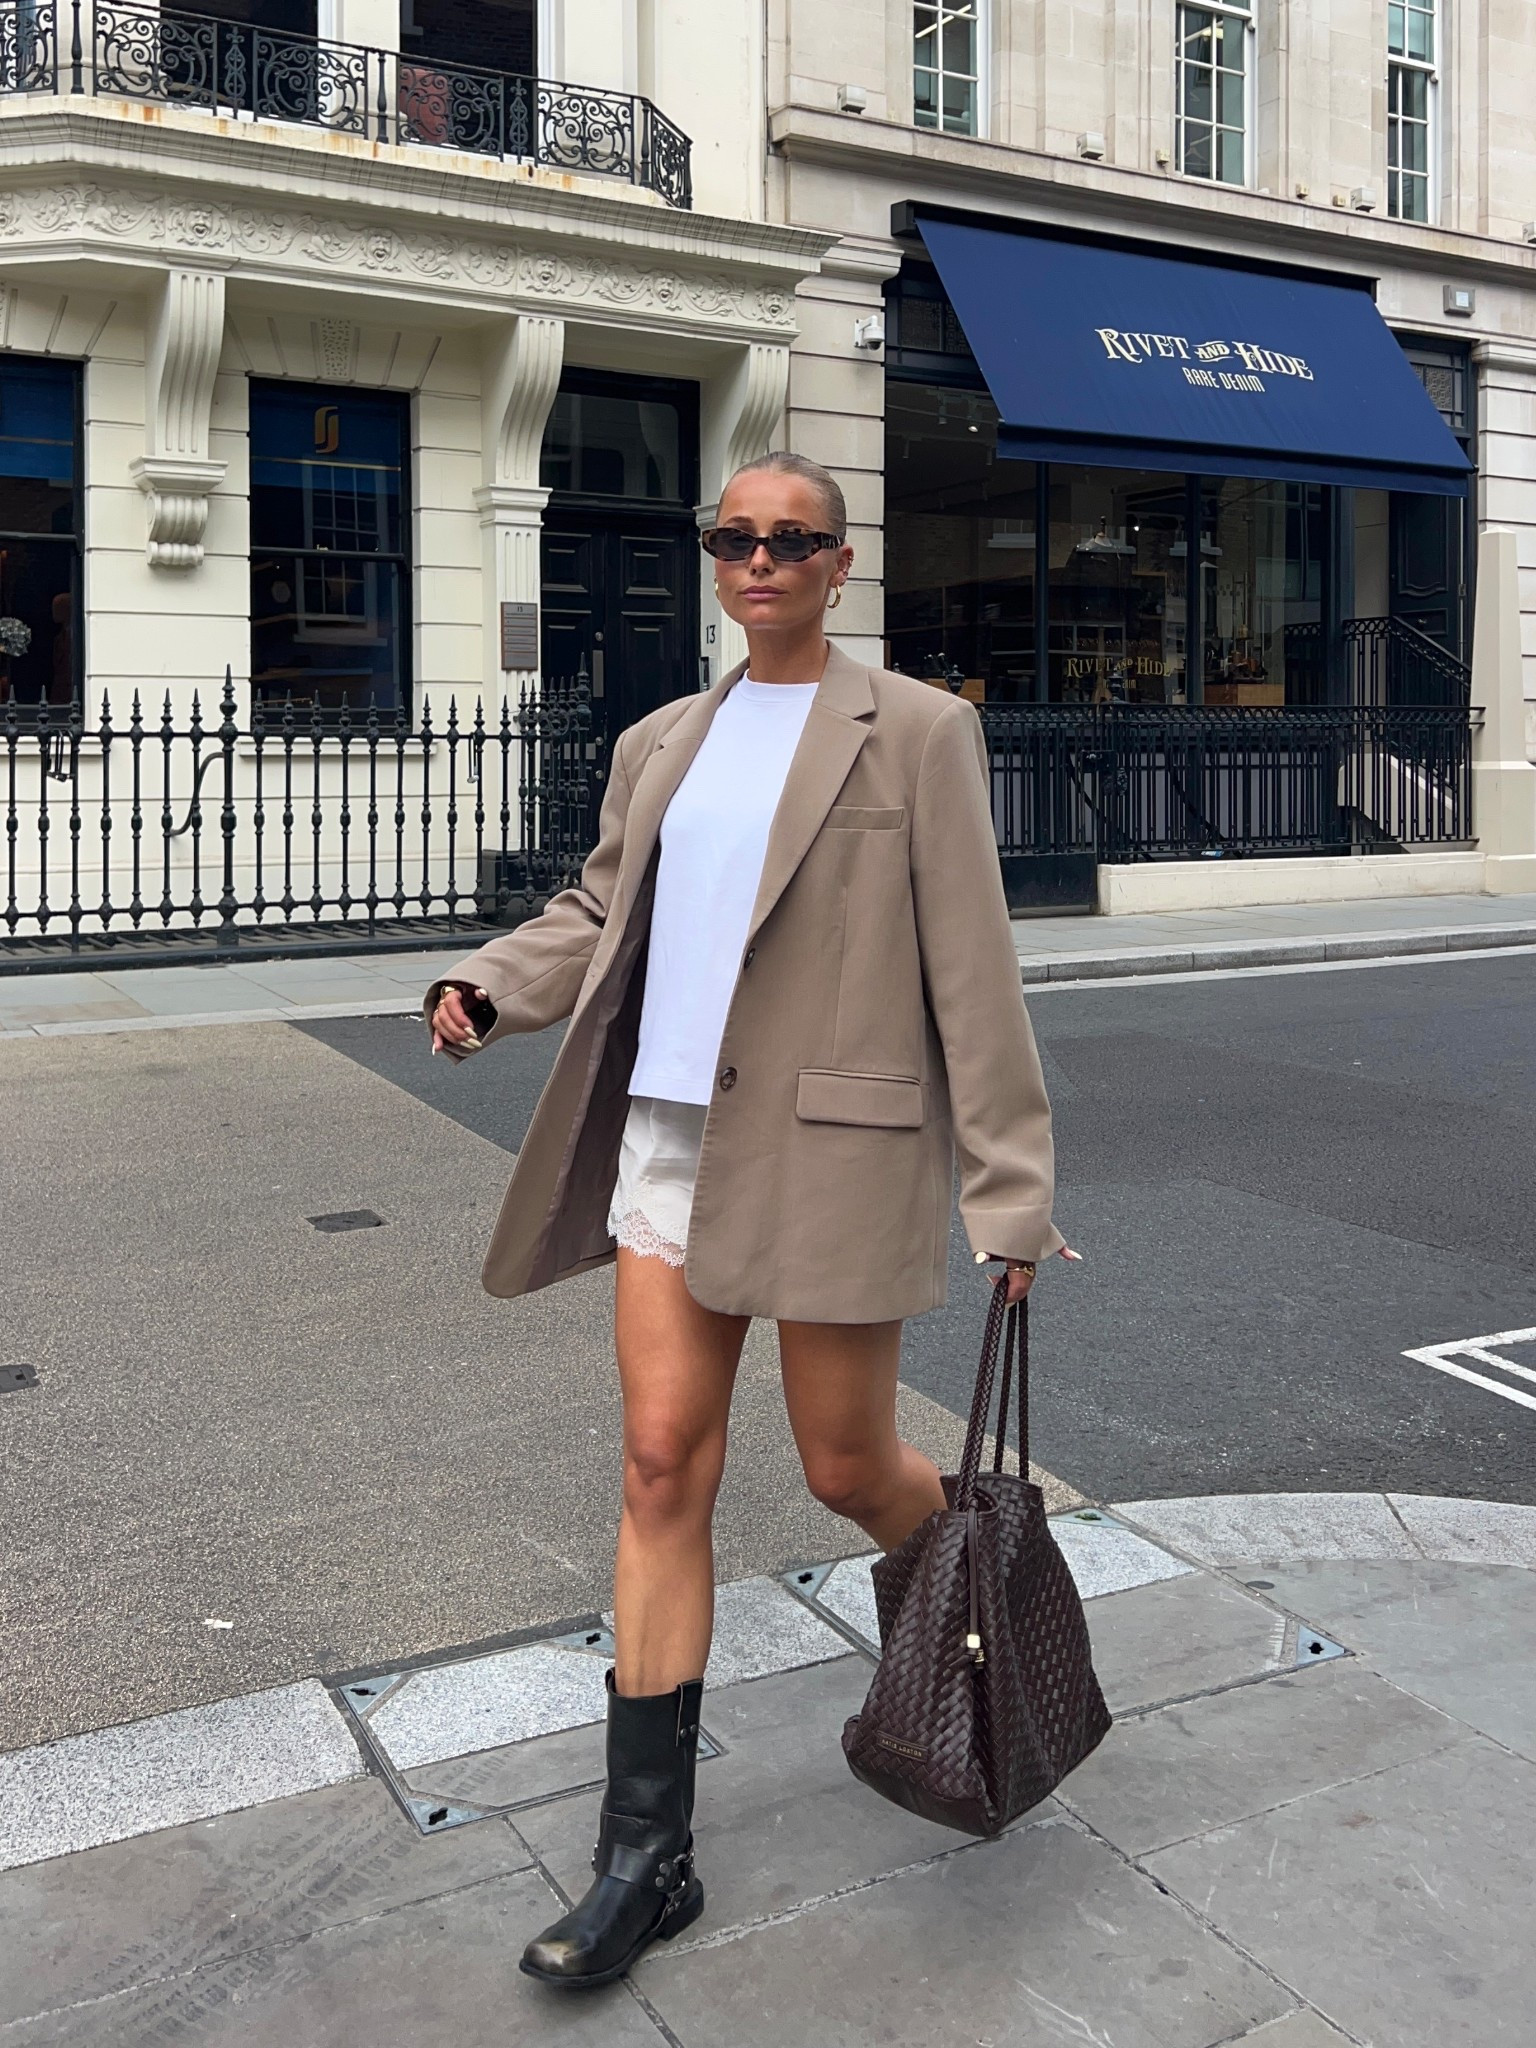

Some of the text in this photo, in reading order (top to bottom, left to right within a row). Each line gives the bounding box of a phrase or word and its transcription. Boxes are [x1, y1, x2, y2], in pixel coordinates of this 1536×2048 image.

[1095, 328, 1314, 381] RIVET AND HIDE
[1182, 366, 1265, 392] RARE DENIM
[706, 624, 716, 644] 13
